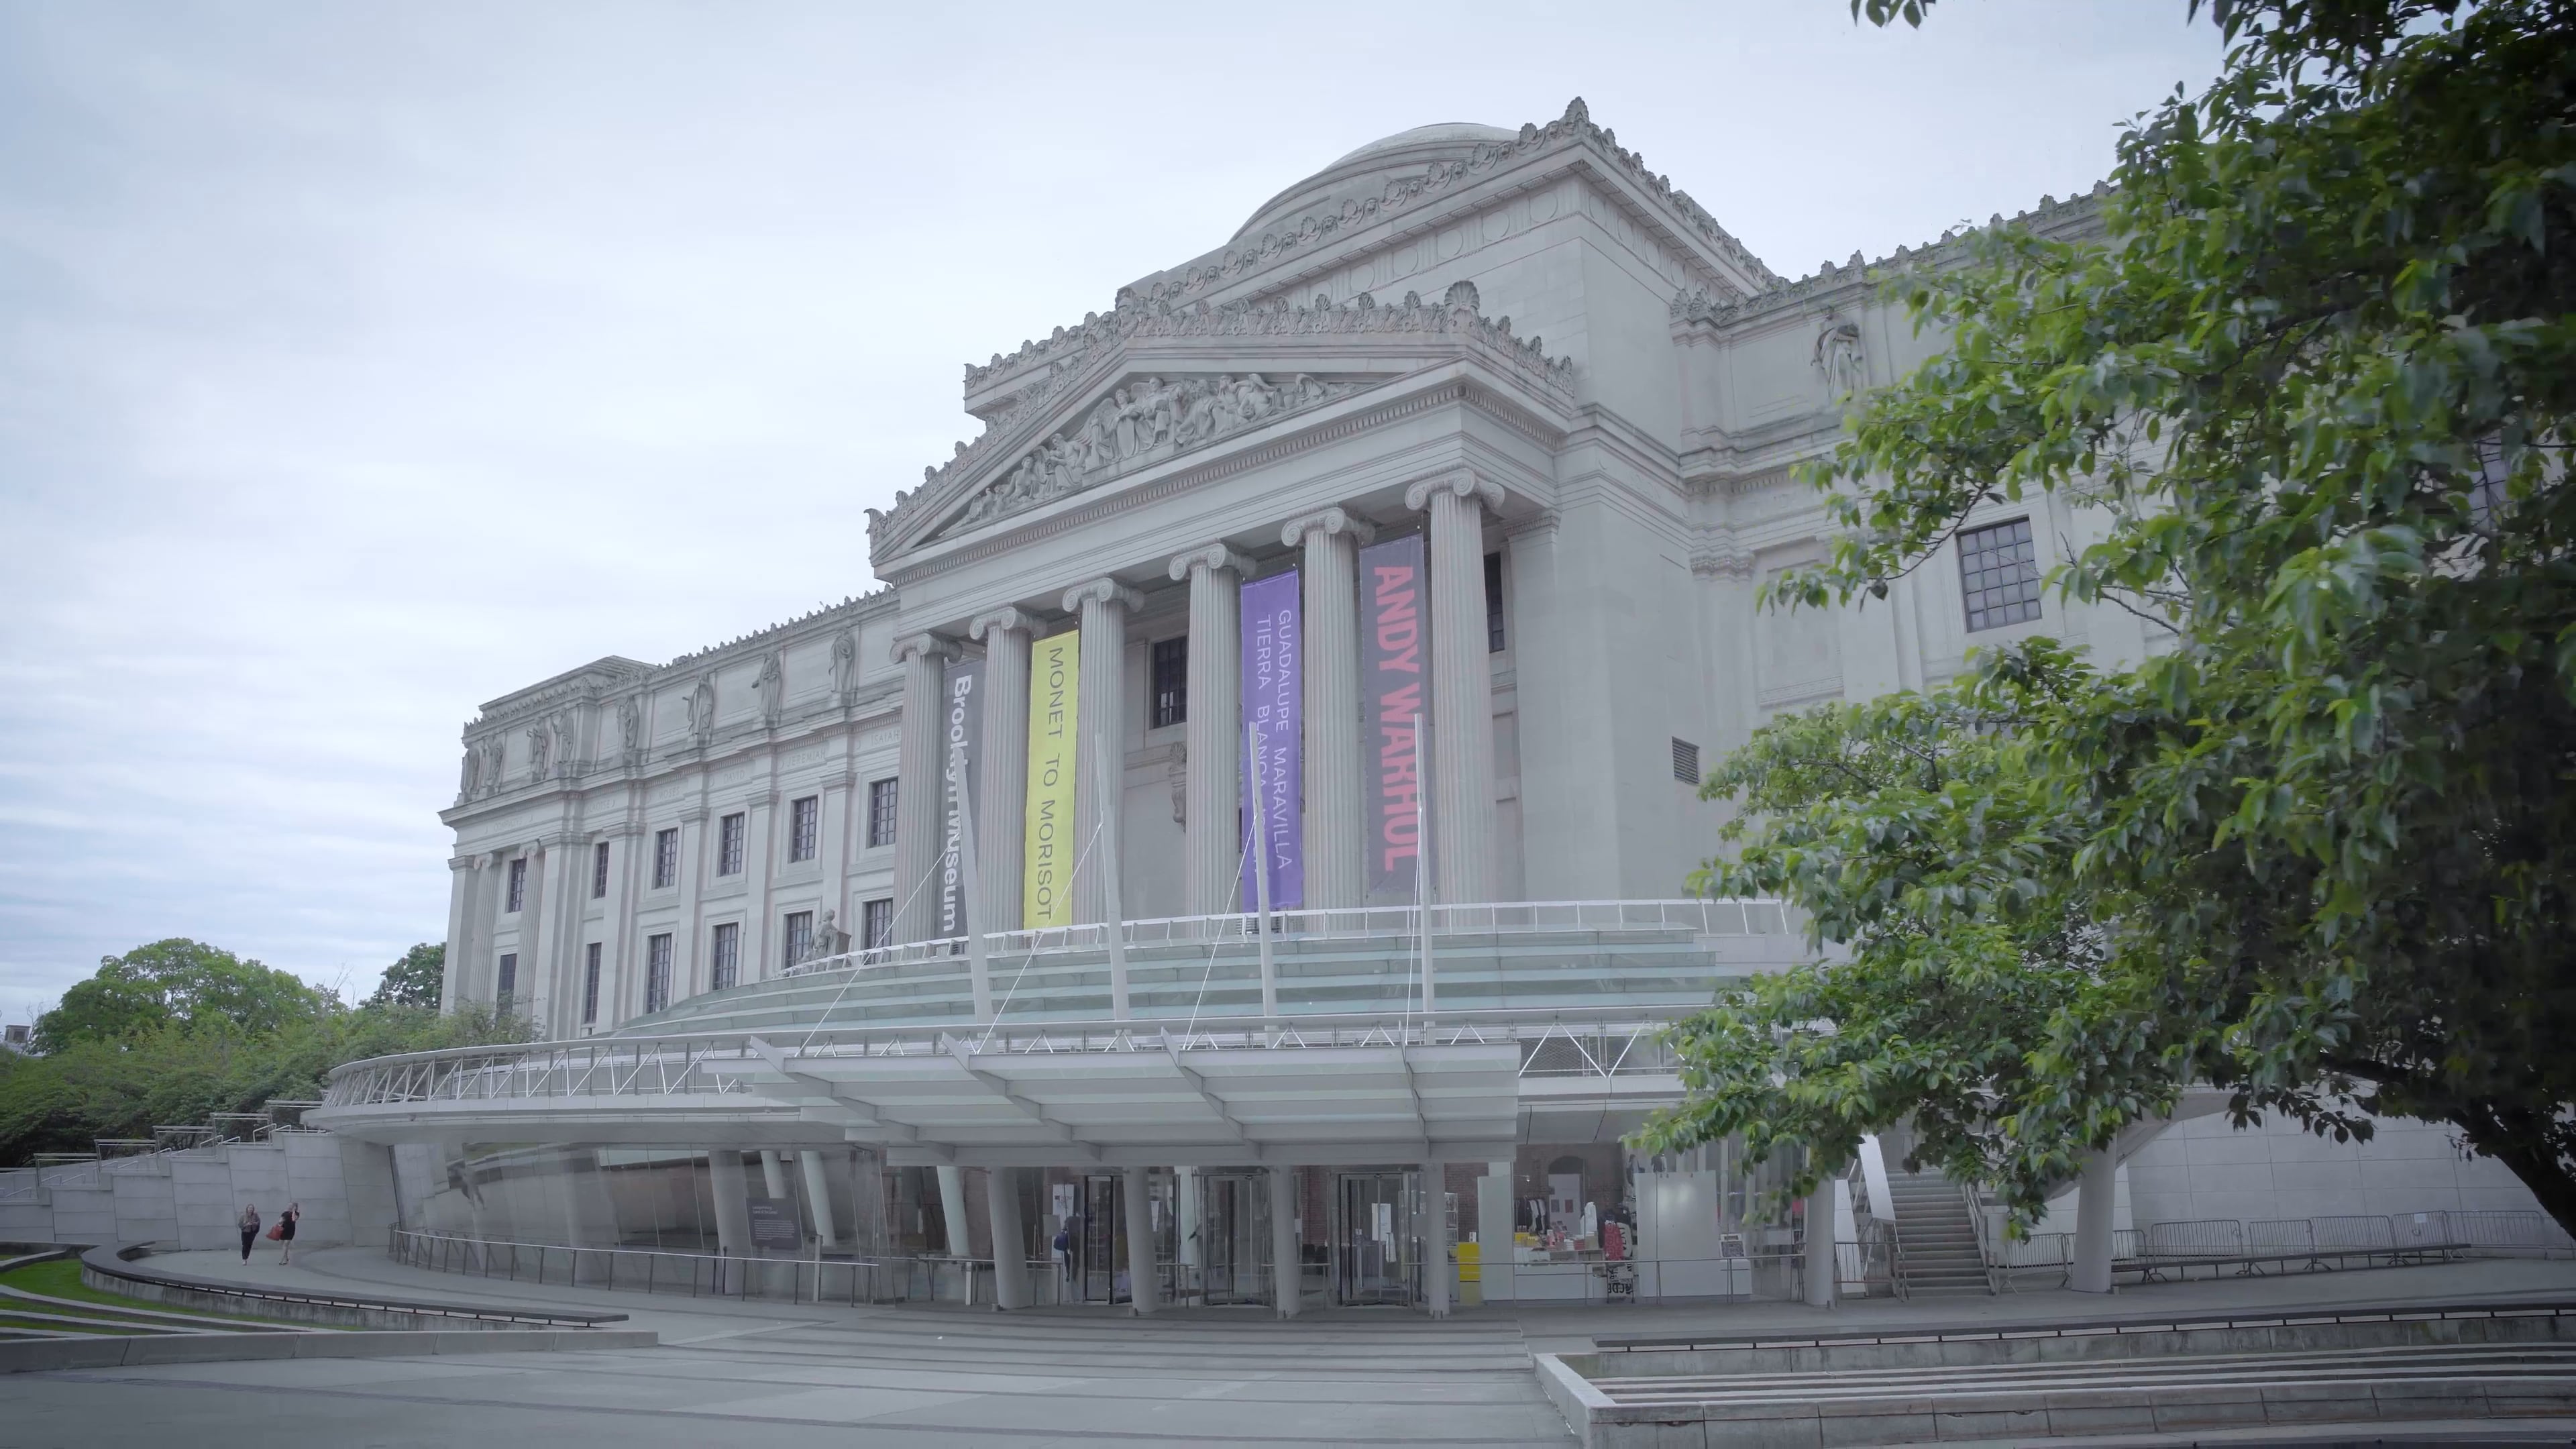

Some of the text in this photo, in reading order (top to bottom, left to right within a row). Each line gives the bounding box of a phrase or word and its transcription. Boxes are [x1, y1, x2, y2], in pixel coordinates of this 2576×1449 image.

[1256, 614, 1272, 690] TIERRA
[787, 747, 826, 767] JEREMIAH
[871, 729, 900, 747] ISAIAH
[1273, 609, 1293, 869] GUADALUPE MARAVILLA
[1374, 566, 1424, 872] ANDY WARHOL
[724, 769, 745, 784] DAVID
[1037, 647, 1065, 920] MONET TO MORISOT
[943, 810, 961, 932] Museum
